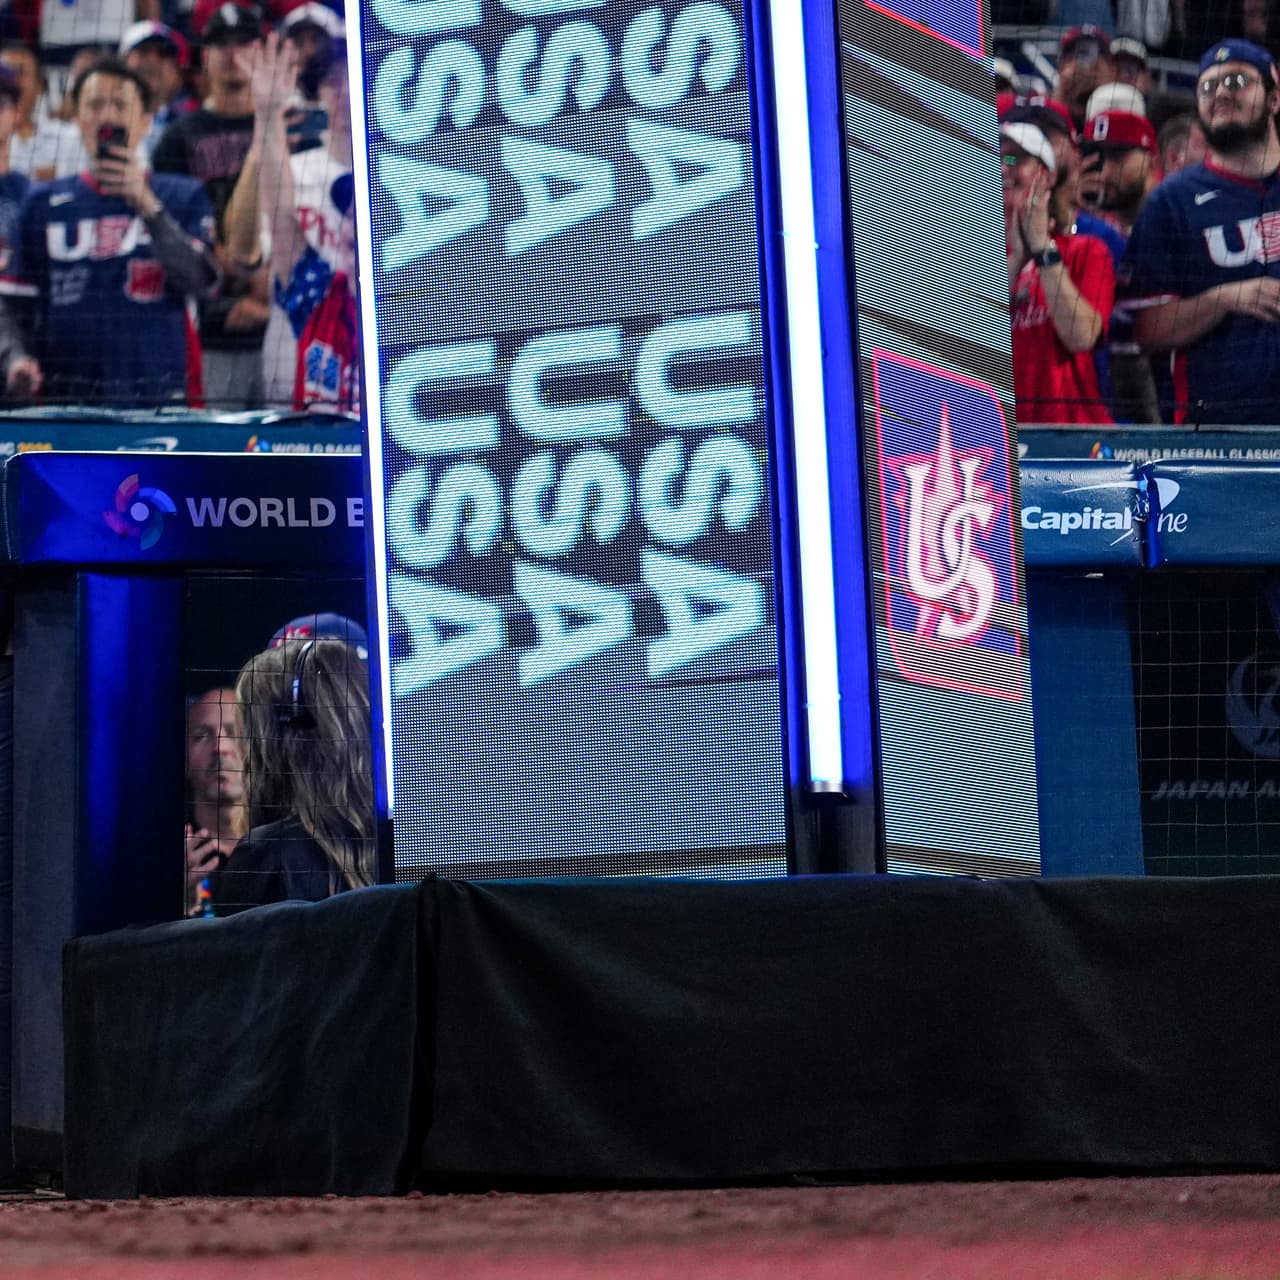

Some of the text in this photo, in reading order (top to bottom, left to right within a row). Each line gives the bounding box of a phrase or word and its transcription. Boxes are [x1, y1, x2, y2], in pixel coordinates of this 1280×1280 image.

[185, 497, 336, 528] WORLD
[384, 339, 505, 698] USA
[508, 326, 631, 686] USA
[637, 310, 764, 677] USA
[1163, 448, 1225, 460] BASEBALL
[1151, 779, 1250, 801] JAPAN
